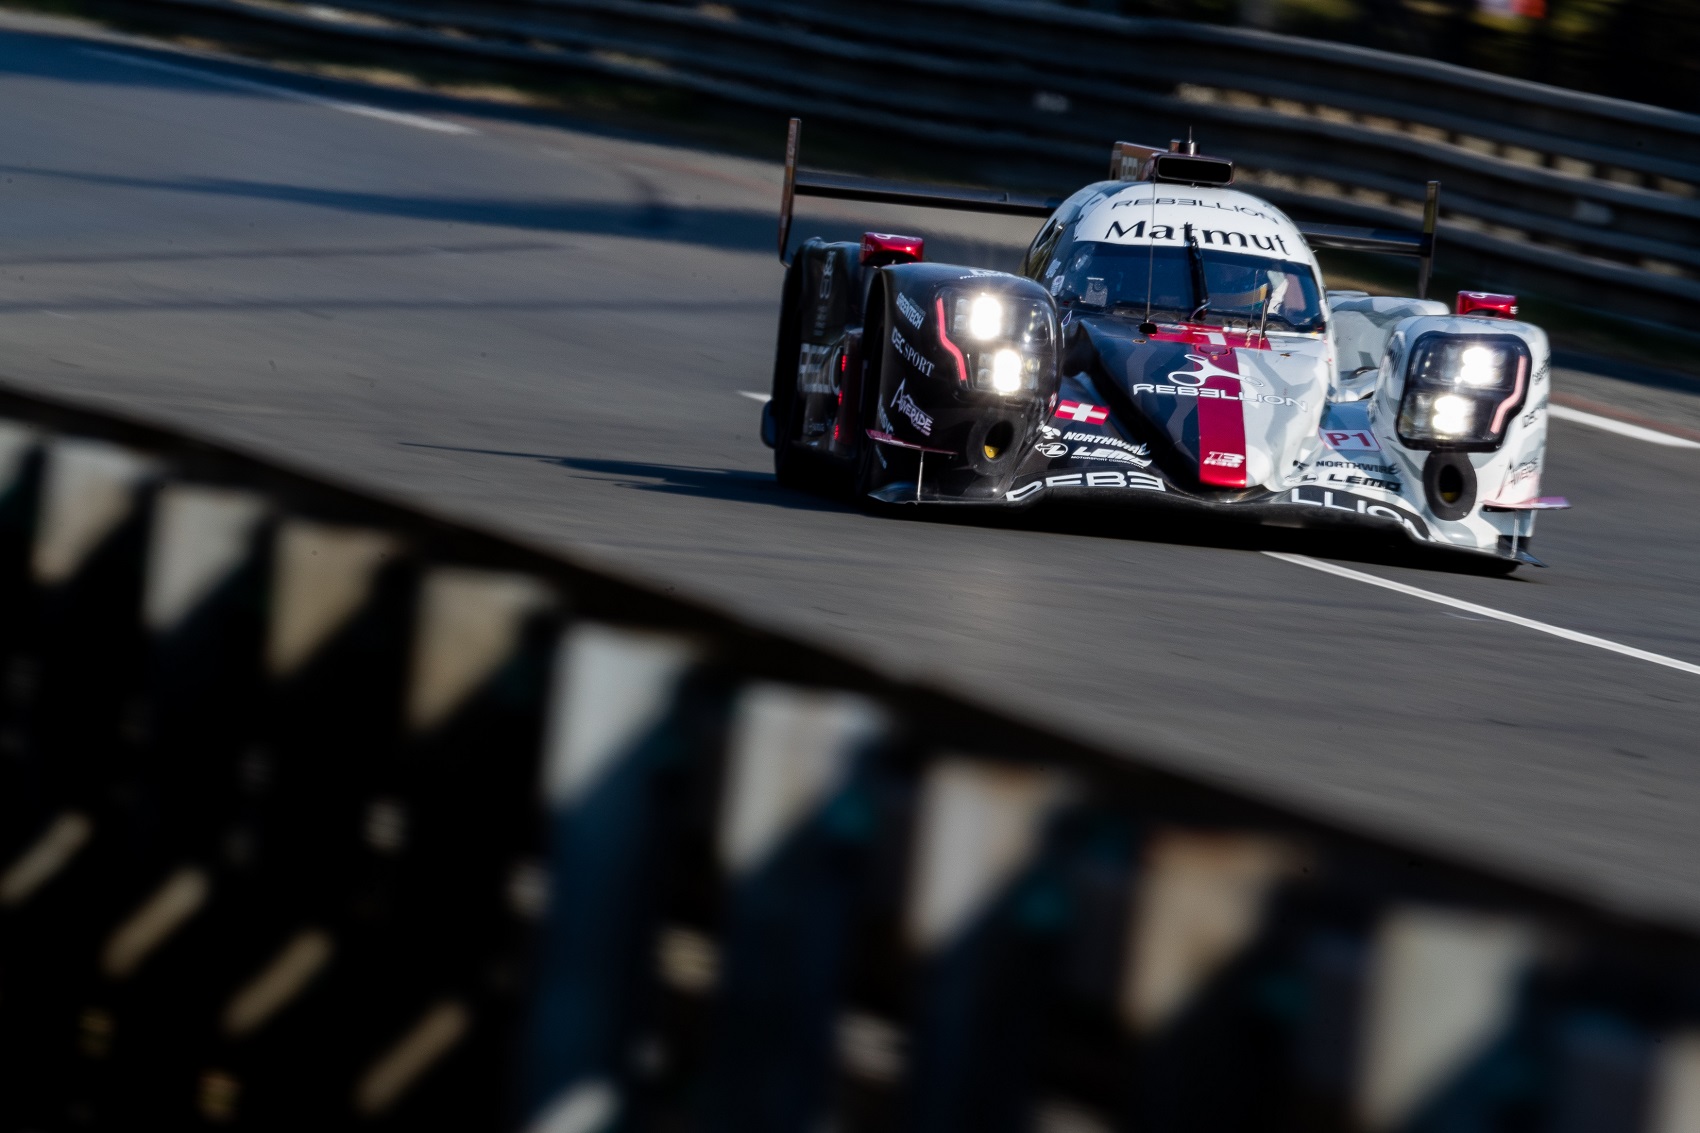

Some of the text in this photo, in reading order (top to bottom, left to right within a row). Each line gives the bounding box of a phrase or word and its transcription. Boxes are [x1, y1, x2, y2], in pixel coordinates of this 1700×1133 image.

[1111, 197, 1279, 225] REBELLION
[1104, 220, 1291, 256] Matmut
[904, 344, 935, 377] SPORT
[1133, 383, 1307, 412] REBELLION
[1325, 432, 1371, 447] P1
[1316, 460, 1401, 475] NORTHWIRE
